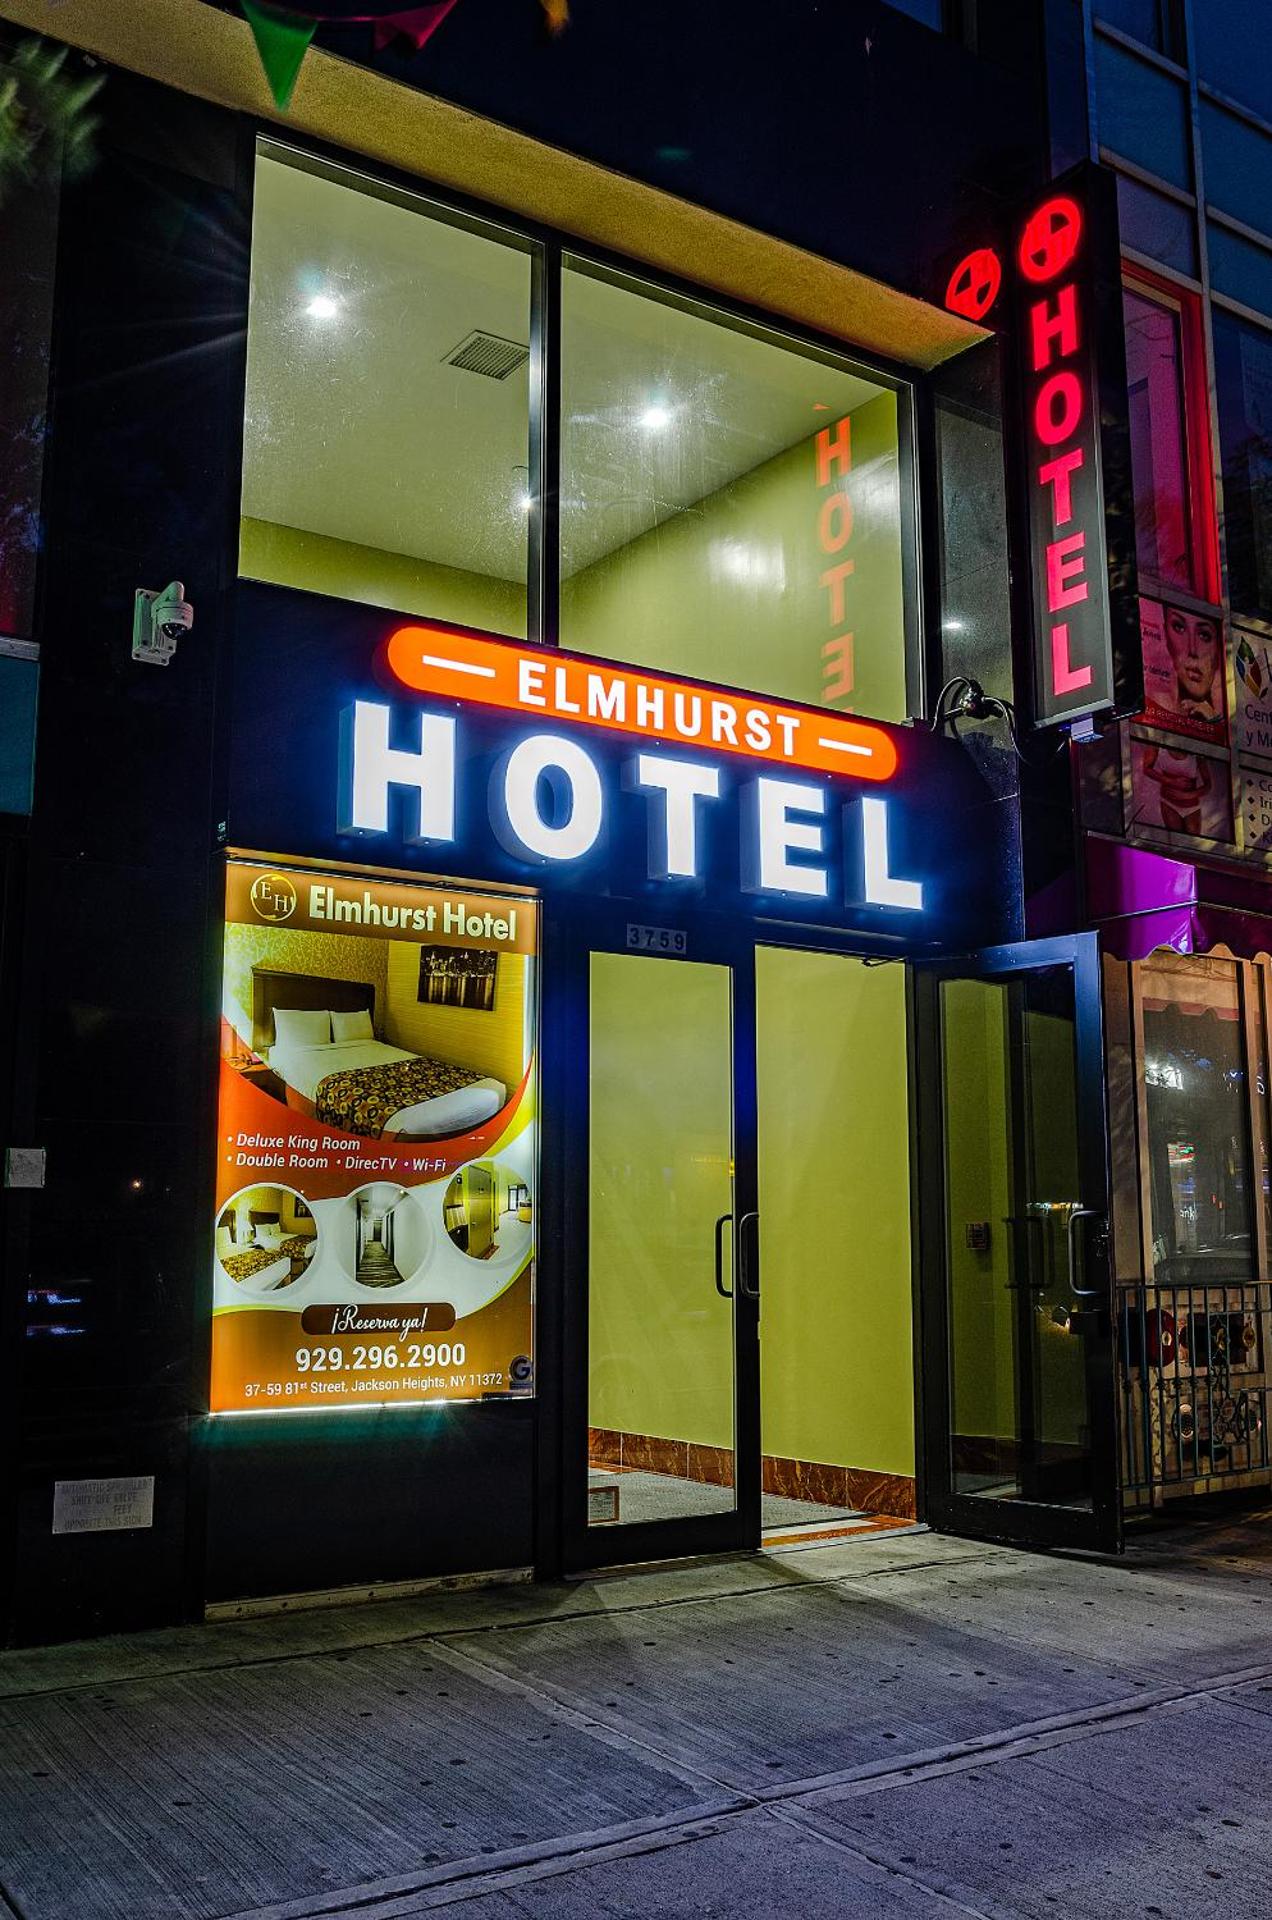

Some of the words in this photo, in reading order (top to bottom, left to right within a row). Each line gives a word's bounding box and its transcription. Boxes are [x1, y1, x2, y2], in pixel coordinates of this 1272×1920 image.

[1030, 283, 1092, 697] HOTEL
[518, 658, 800, 756] ELMHURST
[1258, 730, 1272, 747] M
[346, 699, 923, 912] HOTEL
[309, 884, 437, 932] Elmhurst
[443, 901, 517, 941] Hotel
[629, 927, 685, 951] 3759
[236, 1133, 283, 1149] Deluxe
[288, 1135, 318, 1151] King
[322, 1136, 361, 1151] Room
[236, 1153, 284, 1168] Double
[288, 1155, 328, 1169] Room
[345, 1156, 397, 1170] DirecTV
[413, 1158, 446, 1171] Wi-Fi
[331, 1304, 399, 1335] ¡Reserva
[399, 1307, 428, 1342] ya!
[295, 1343, 466, 1373] 929.296.2900
[245, 1382, 282, 1398] 37-59
[310, 1380, 348, 1395] Street,
[351, 1378, 399, 1392] Jackson
[402, 1375, 448, 1391] Heights,
[450, 1374, 466, 1387] NY
[469, 1373, 503, 1387] 11372
